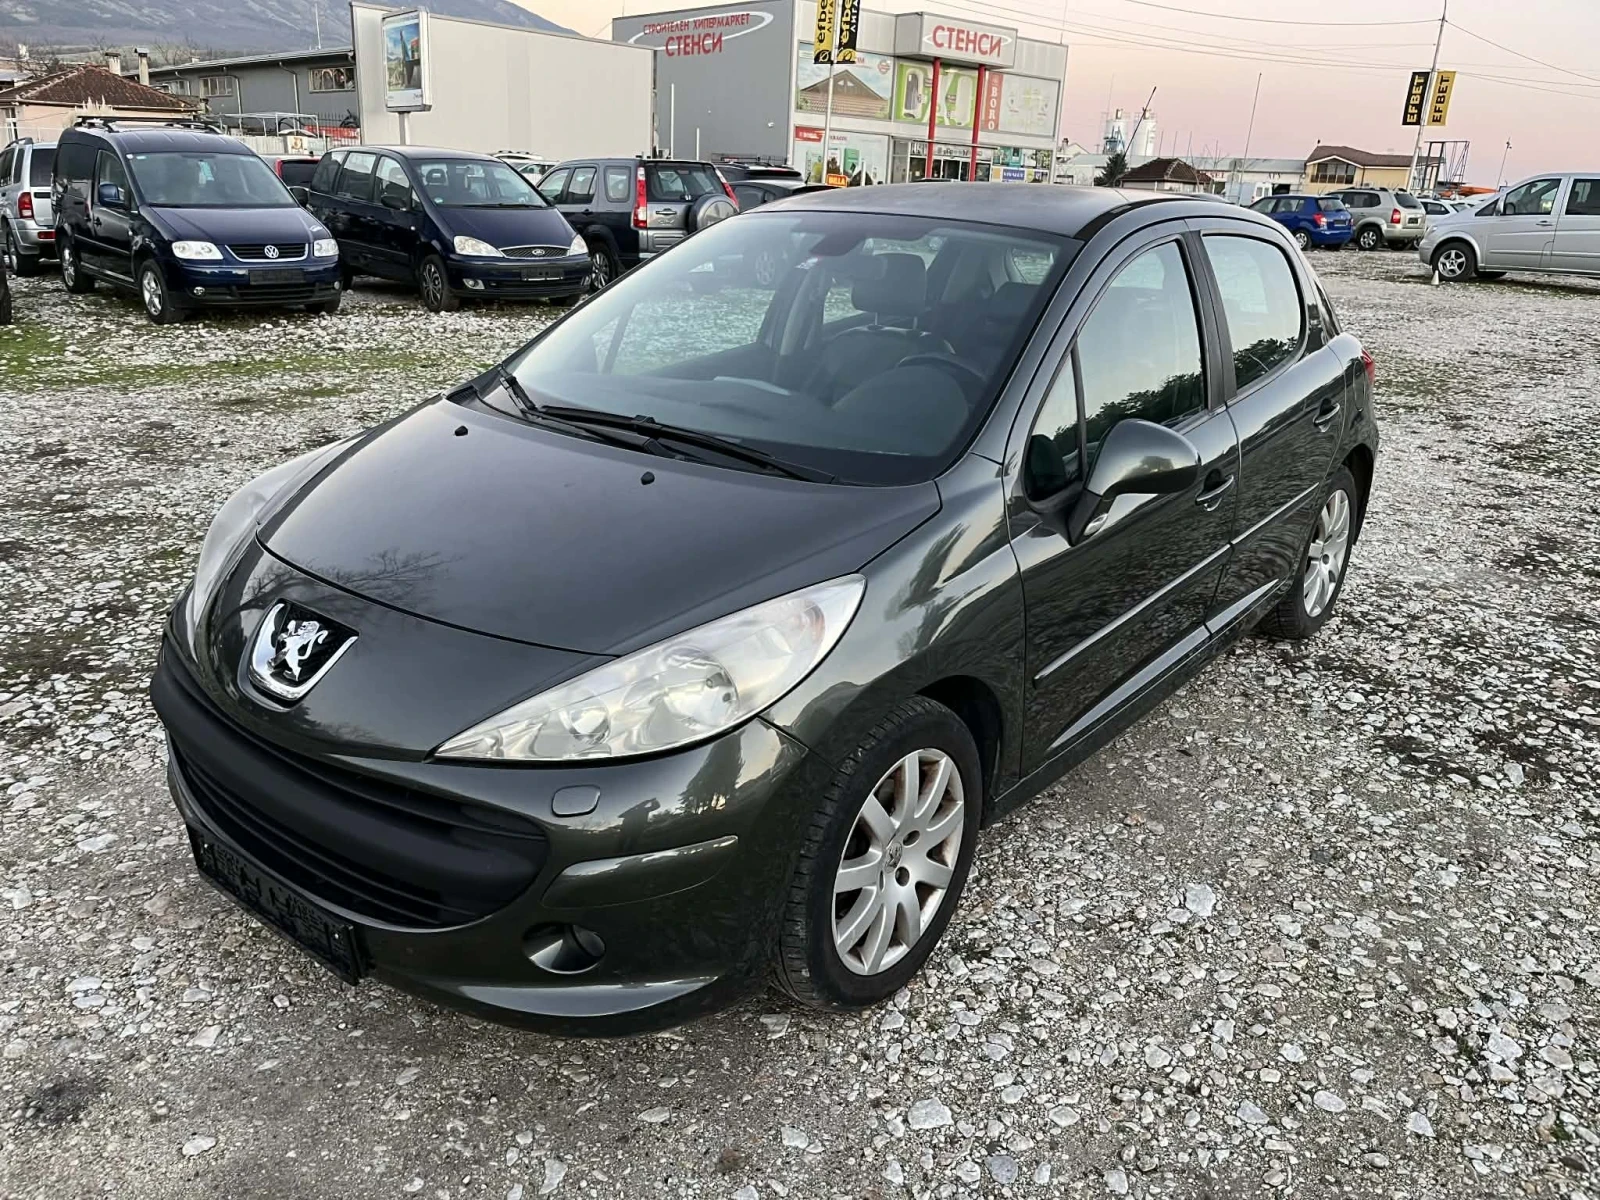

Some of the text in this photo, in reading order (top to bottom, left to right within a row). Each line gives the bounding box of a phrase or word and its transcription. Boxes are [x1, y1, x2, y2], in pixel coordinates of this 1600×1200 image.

[643, 13, 750, 35] СТРОИТЕЛЕН ХИПЕРМАРКЕТ
[665, 32, 723, 57] СТЕНСИ
[932, 25, 1002, 57] СТЕНСИ
[1406, 75, 1425, 123] EFBET
[1432, 75, 1451, 123] EFBET
